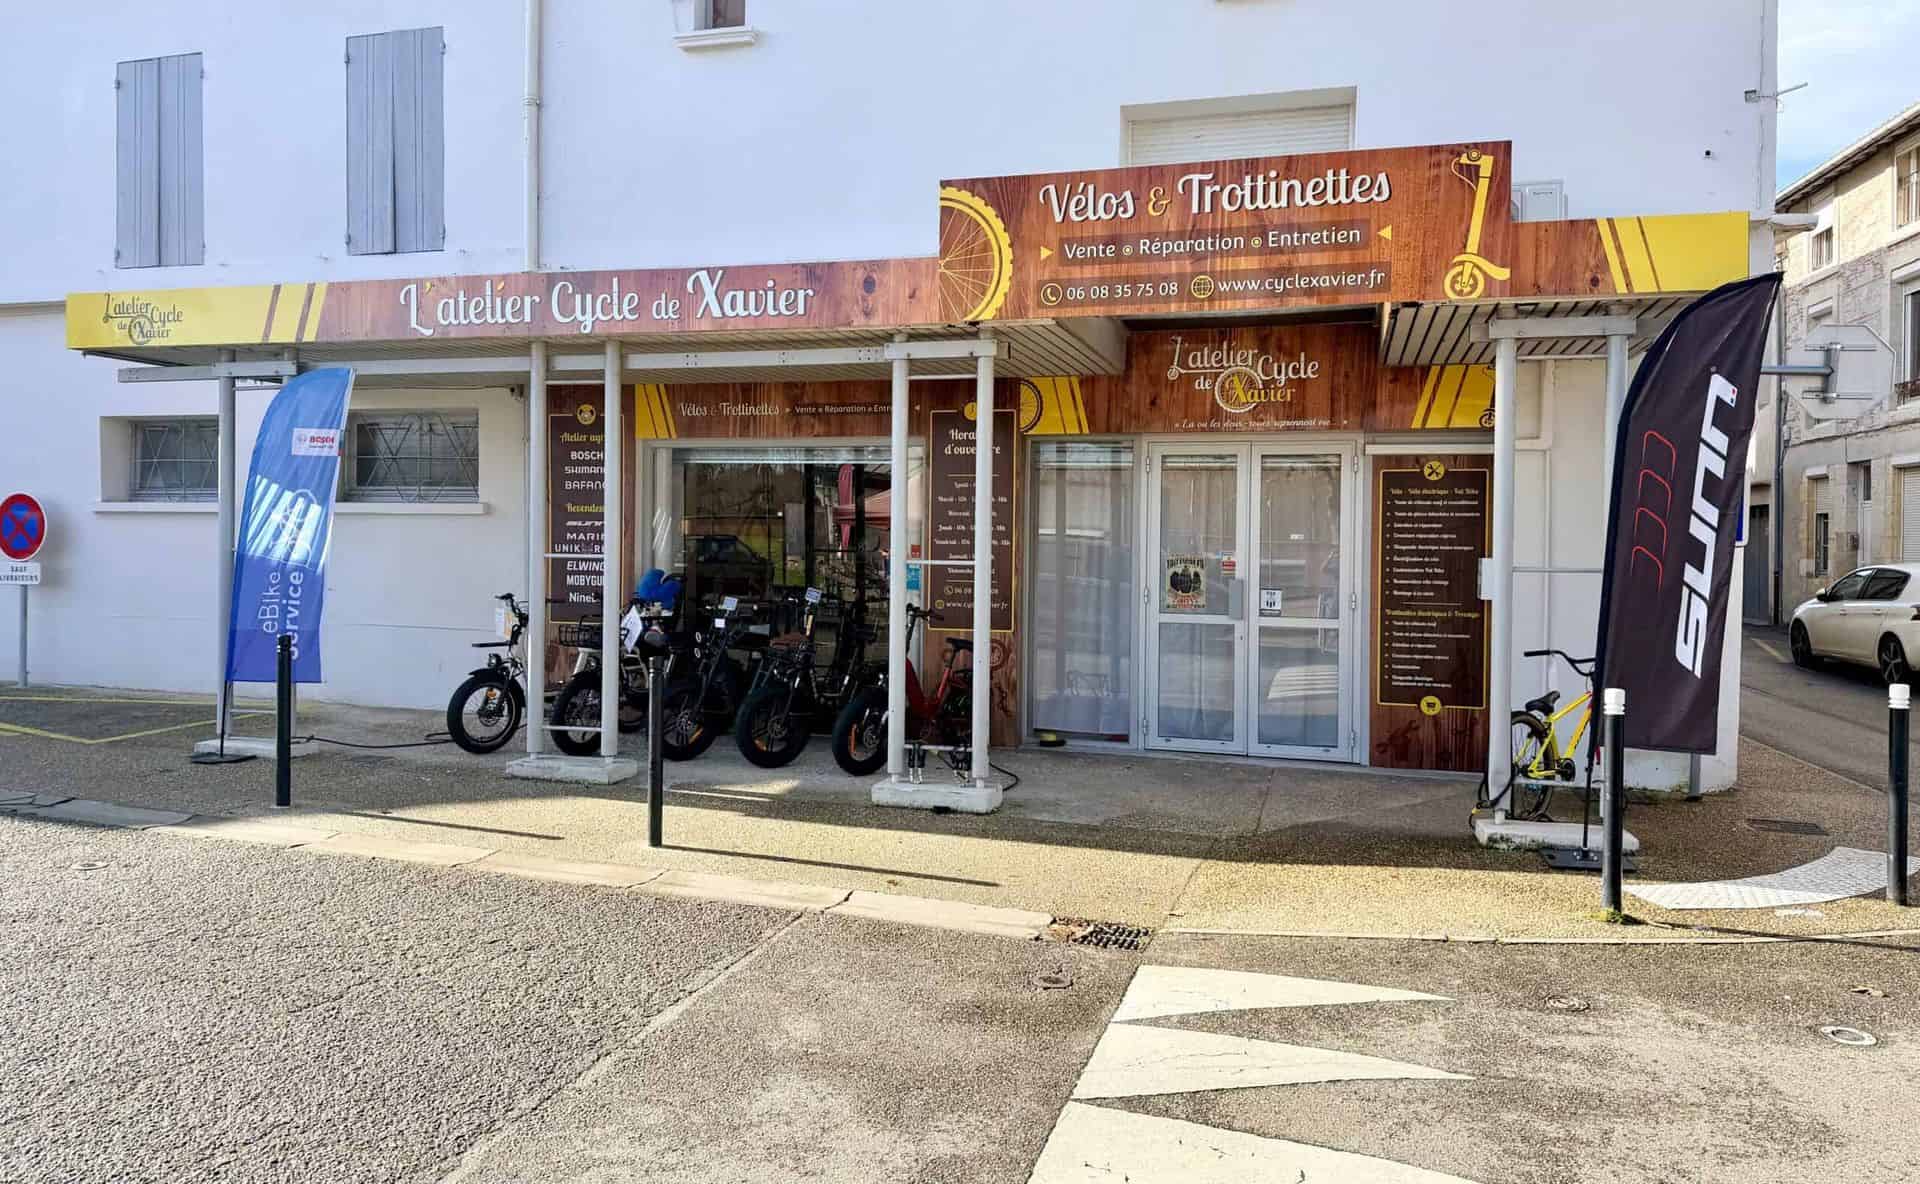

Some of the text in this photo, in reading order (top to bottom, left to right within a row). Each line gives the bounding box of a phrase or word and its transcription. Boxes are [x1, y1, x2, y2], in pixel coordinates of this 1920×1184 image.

[1039, 168, 1392, 223] Vélos & Trottinettes
[1064, 227, 1361, 260] Vente Réparation Entretien
[1066, 270, 1386, 301] 06 08 35 75 08 www.cyclexavier.fr
[400, 268, 815, 336] L'atelier Cycle de Xavier
[103, 291, 184, 329] L'atelier Cycle
[117, 320, 173, 340] de Xavier
[1167, 336, 1320, 387] L'atelier Cycle
[1194, 374, 1296, 403] de Xavier
[680, 402, 708, 417] Vélos
[719, 402, 780, 416] Trottinettes
[795, 405, 817, 414] Vente
[824, 404, 866, 414] Réparation
[560, 431, 588, 444] Atelier
[949, 429, 977, 441] Hora
[570, 450, 604, 460] BOSCH
[944, 443, 1001, 455] d'ouvere
[564, 466, 605, 474] SHIMAN
[565, 502, 606, 513] Revende
[566, 575, 605, 586] MOBYGU
[257, 571, 281, 635] eBike
[569, 591, 601, 603] Nine
